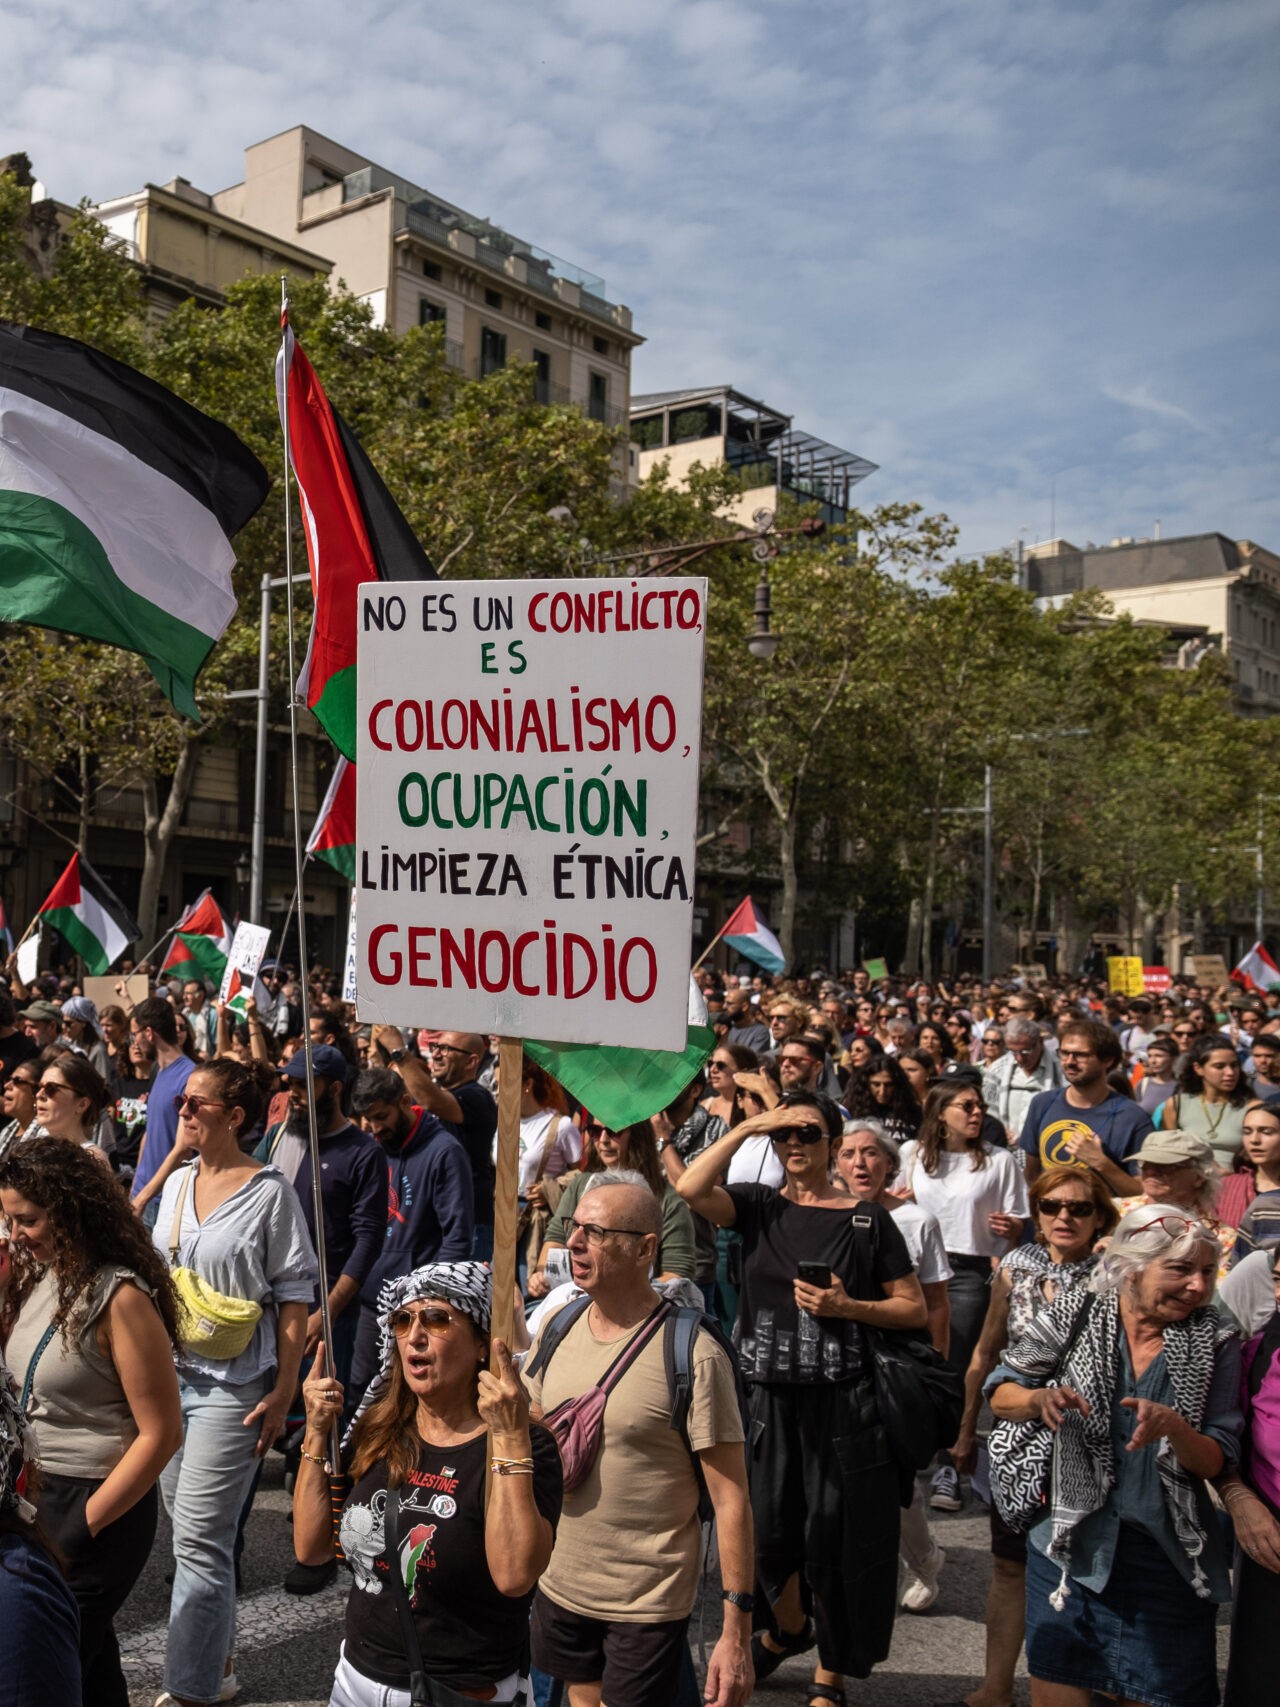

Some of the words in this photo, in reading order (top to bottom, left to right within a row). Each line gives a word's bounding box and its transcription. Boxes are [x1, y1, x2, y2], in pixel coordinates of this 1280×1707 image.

[363, 595, 406, 632] NO
[422, 594, 457, 632] ES
[472, 596, 513, 632] UN
[527, 581, 702, 634] CONFLICTO,
[480, 640, 528, 675] ES
[368, 686, 691, 757] COLONIALISMO,
[361, 845, 527, 896] LIMPIEZA
[552, 843, 693, 904] ÉTNICA,
[367, 919, 658, 1004] GENOCIDIO
